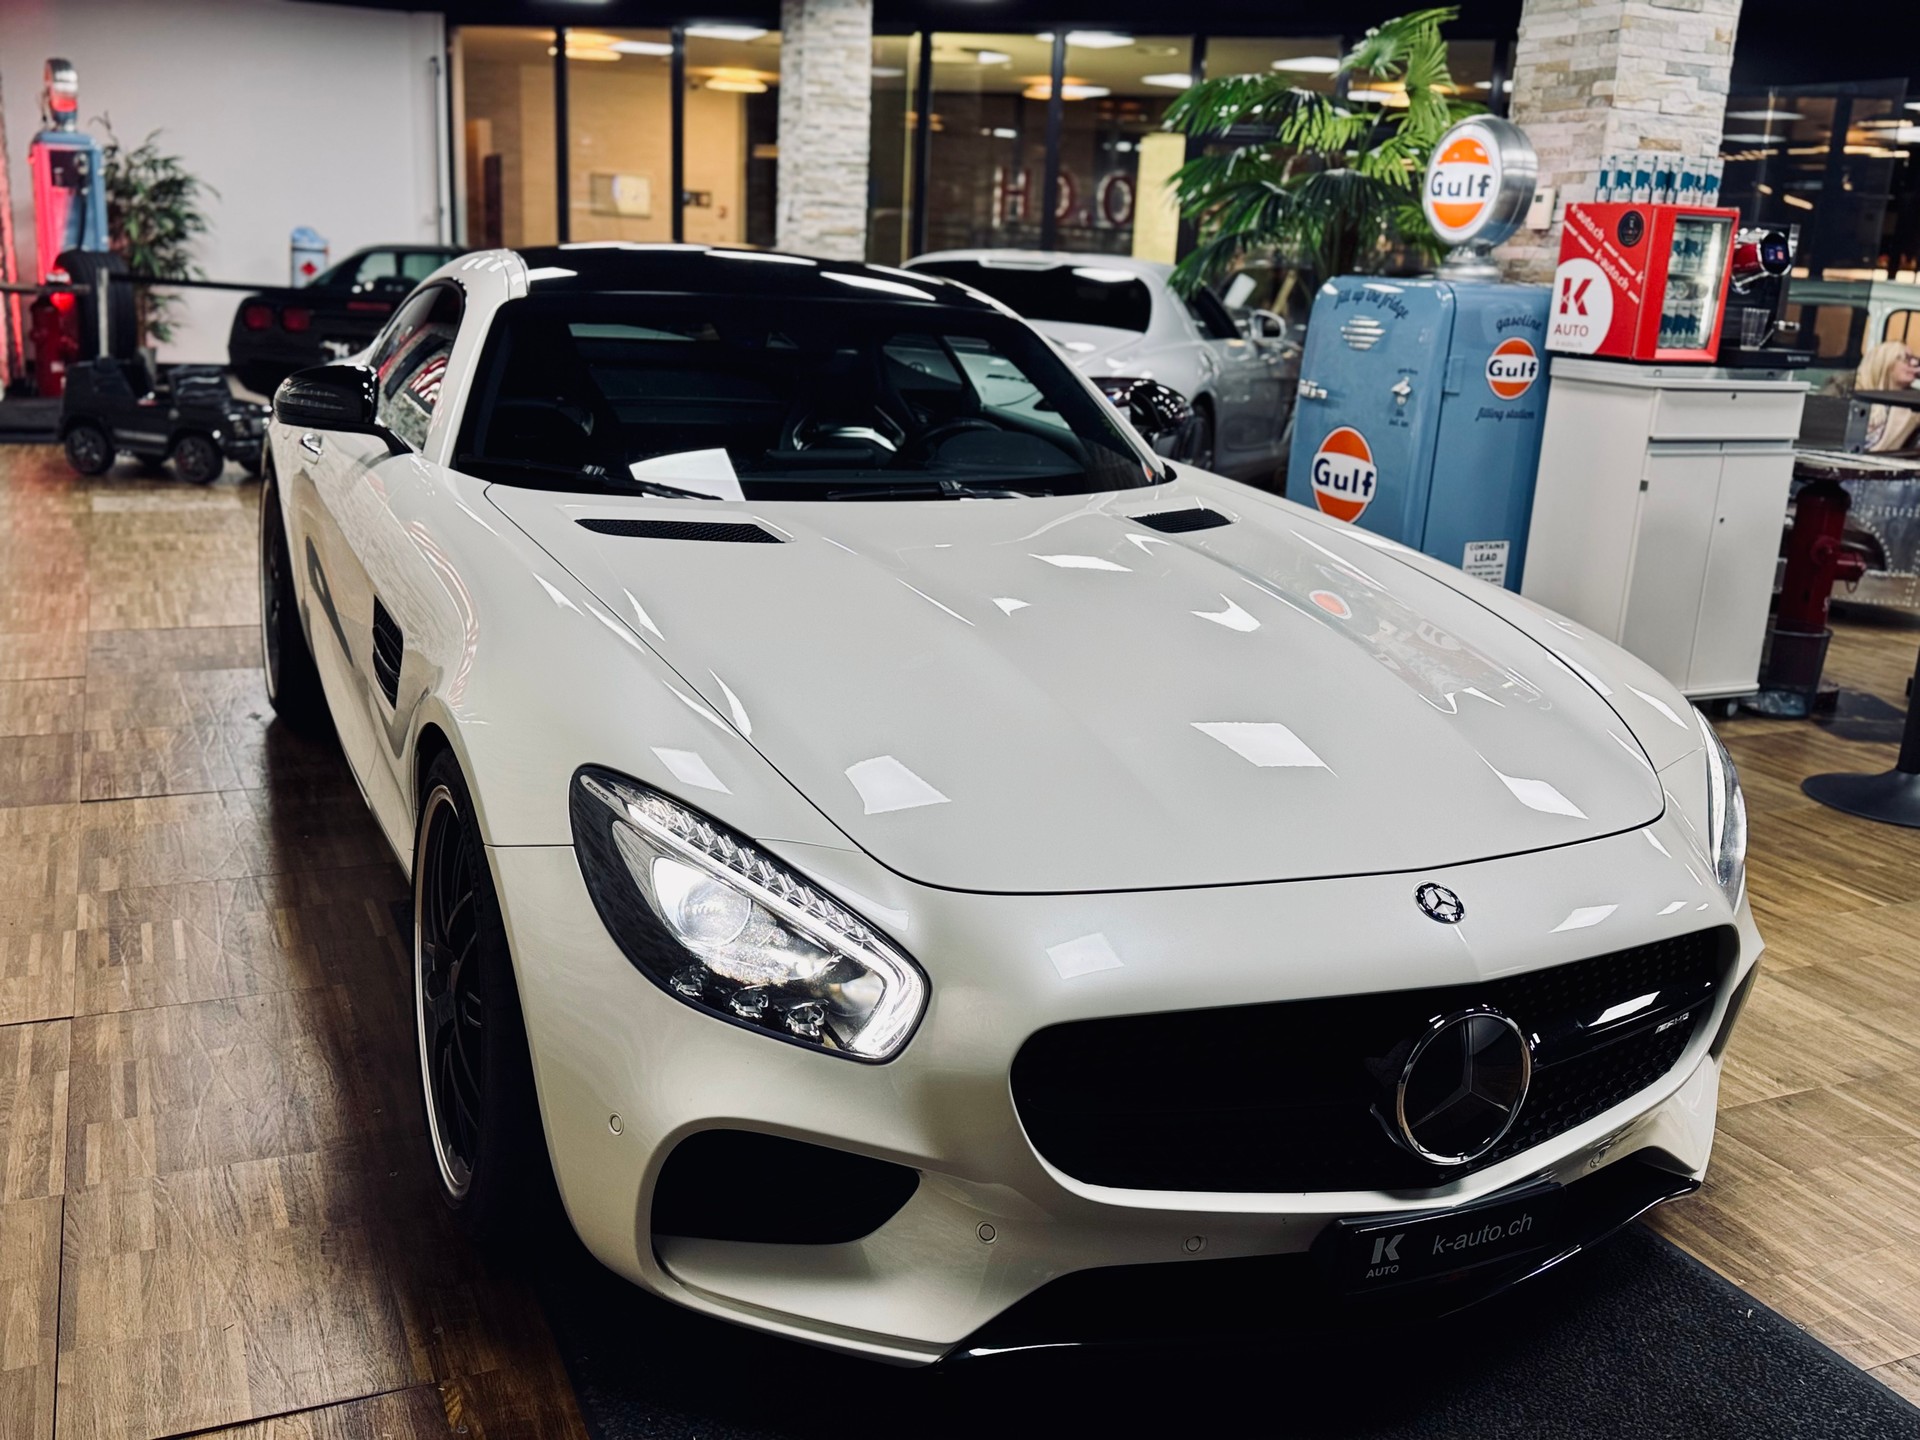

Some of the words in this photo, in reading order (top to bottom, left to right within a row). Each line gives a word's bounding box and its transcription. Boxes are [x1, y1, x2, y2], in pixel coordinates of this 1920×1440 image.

[1431, 170, 1492, 198] Gulf
[1560, 277, 1593, 316] K
[1496, 313, 1542, 333] gasoline
[1554, 322, 1589, 338] AUTO
[1488, 359, 1538, 378] Gulf
[1314, 457, 1375, 497] Gulf
[1469, 542, 1505, 552] CONTAINS
[1474, 552, 1497, 563] LEAD
[1432, 1213, 1533, 1256] k-auto.ch
[1370, 1233, 1405, 1265] K
[1365, 1264, 1400, 1279] AUTO
